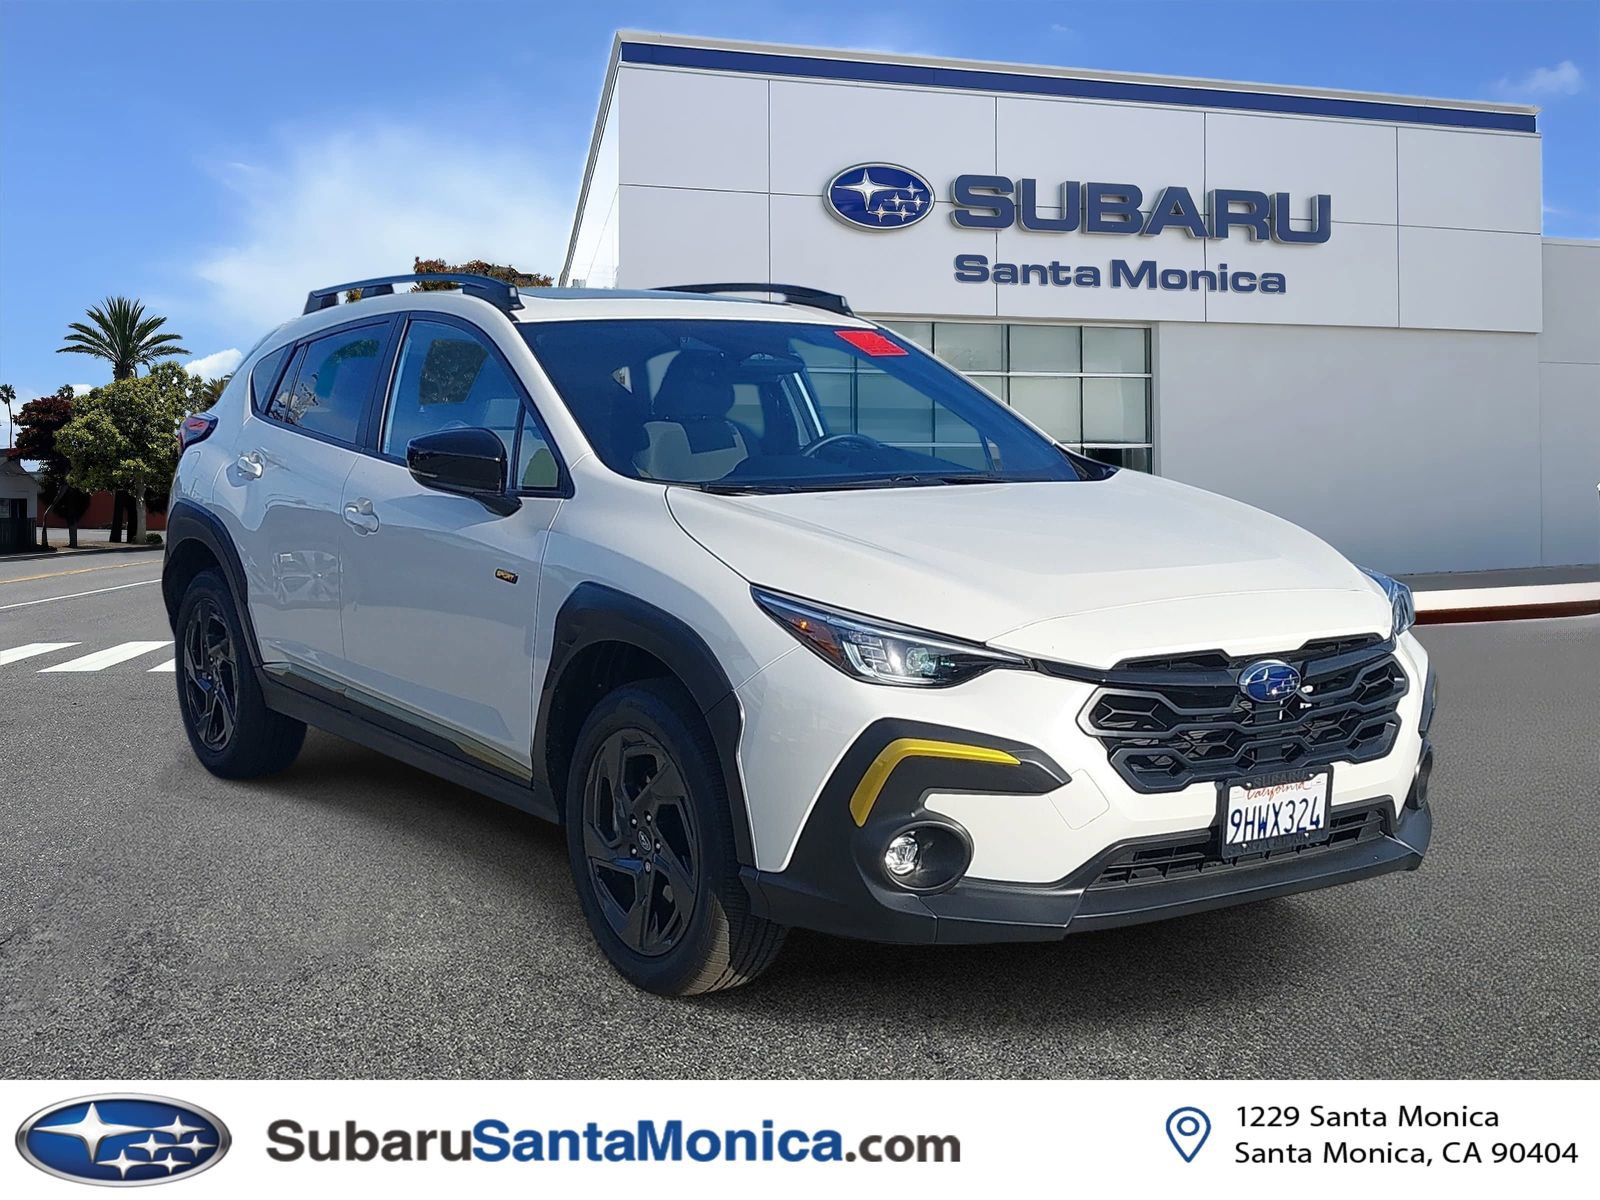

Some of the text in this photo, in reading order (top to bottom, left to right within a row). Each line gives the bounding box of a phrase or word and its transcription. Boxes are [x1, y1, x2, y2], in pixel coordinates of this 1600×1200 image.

[951, 173, 1331, 244] SUBARU
[955, 254, 1286, 293] Santa Monica
[1230, 796, 1320, 844] 9HWX324
